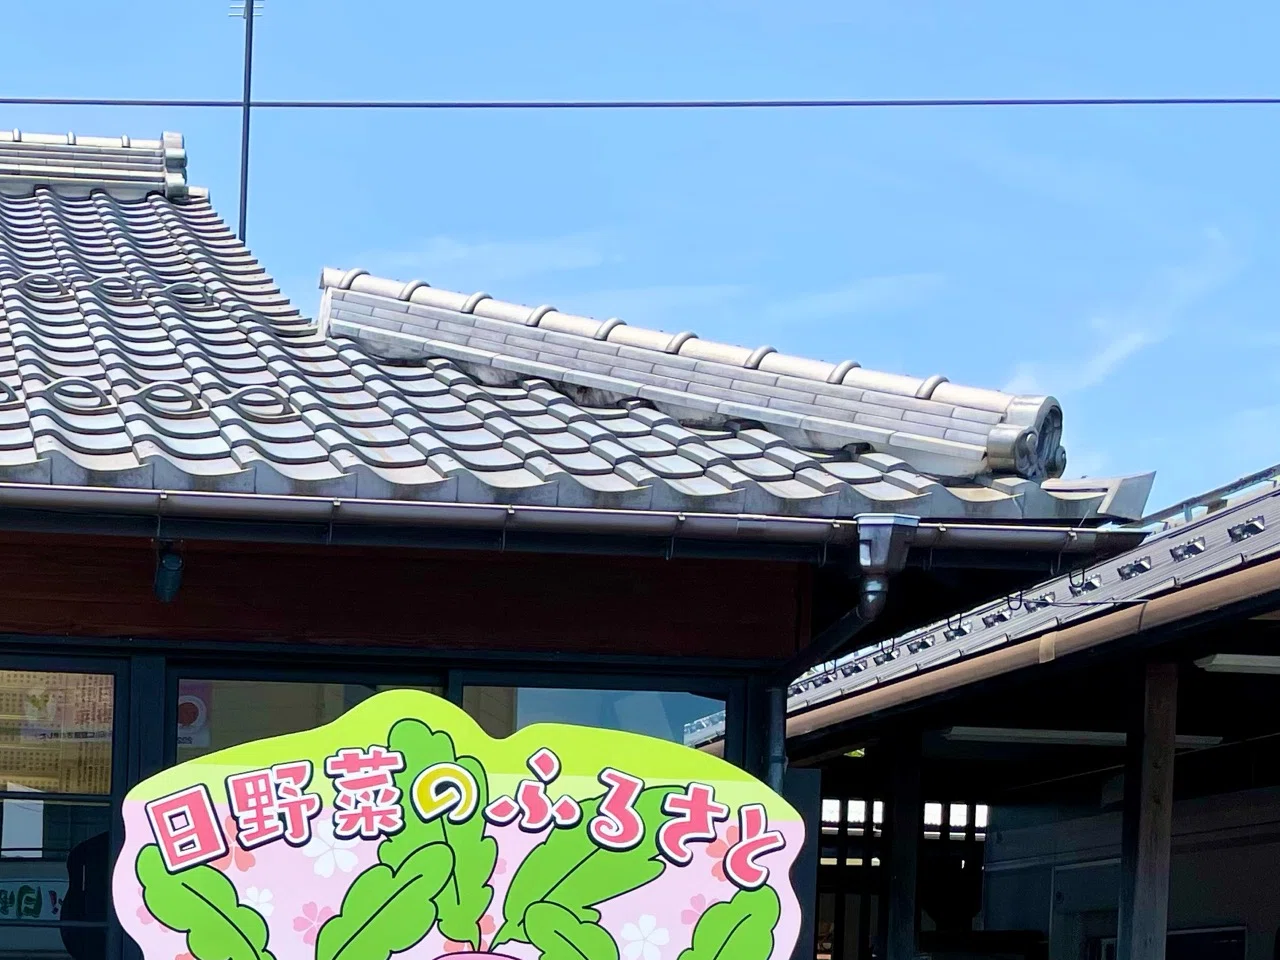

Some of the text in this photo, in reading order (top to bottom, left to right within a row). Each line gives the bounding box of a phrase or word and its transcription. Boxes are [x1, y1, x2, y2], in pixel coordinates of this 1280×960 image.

[146, 746, 786, 889] 日野菜のふるさと
